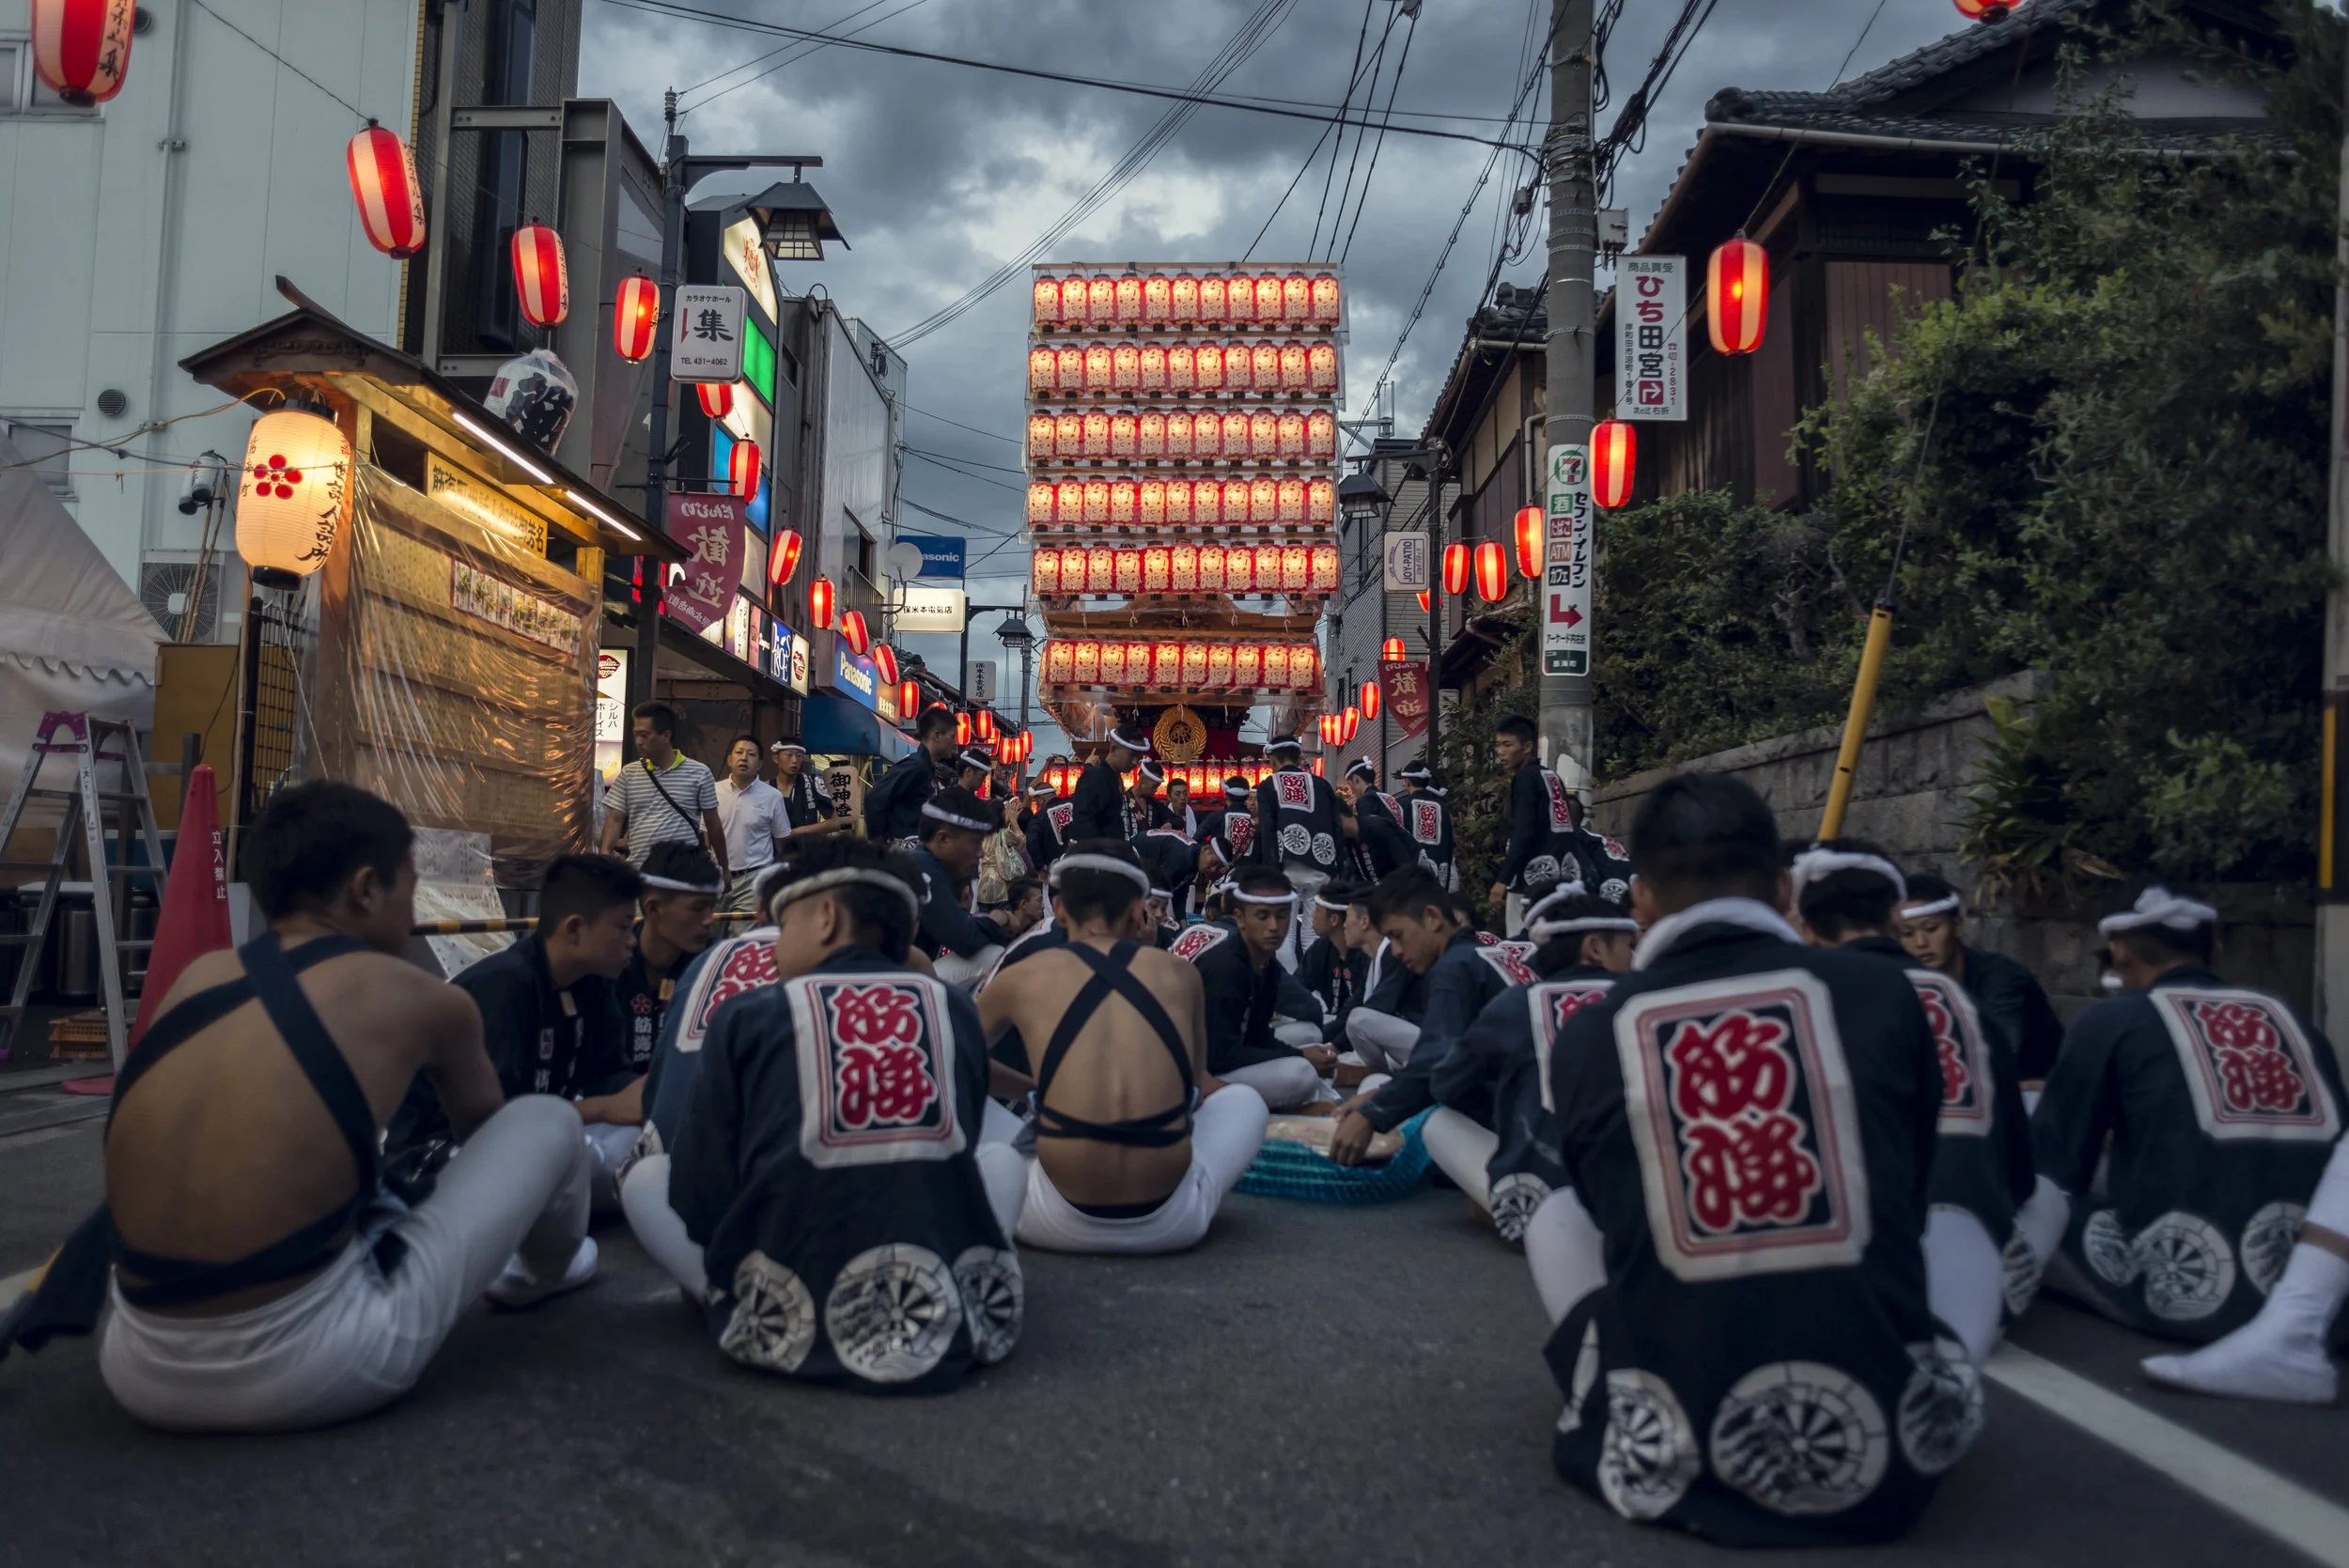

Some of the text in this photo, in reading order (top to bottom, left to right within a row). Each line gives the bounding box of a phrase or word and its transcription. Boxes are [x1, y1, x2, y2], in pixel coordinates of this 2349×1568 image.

[693, 308, 734, 343] 集
[681, 357, 728, 366] TEL 431-4062
[1554, 496, 1570, 512] 酒
[1551, 520, 1571, 536] たばこ
[923, 551, 960, 563] asonic
[1550, 542, 1571, 561] ATM
[1403, 541, 1412, 582] JOY-PATIO
[1549, 567, 1569, 584] カフェ
[840, 650, 873, 696] Panasonic
[212, 831, 226, 899] 立入禁止
